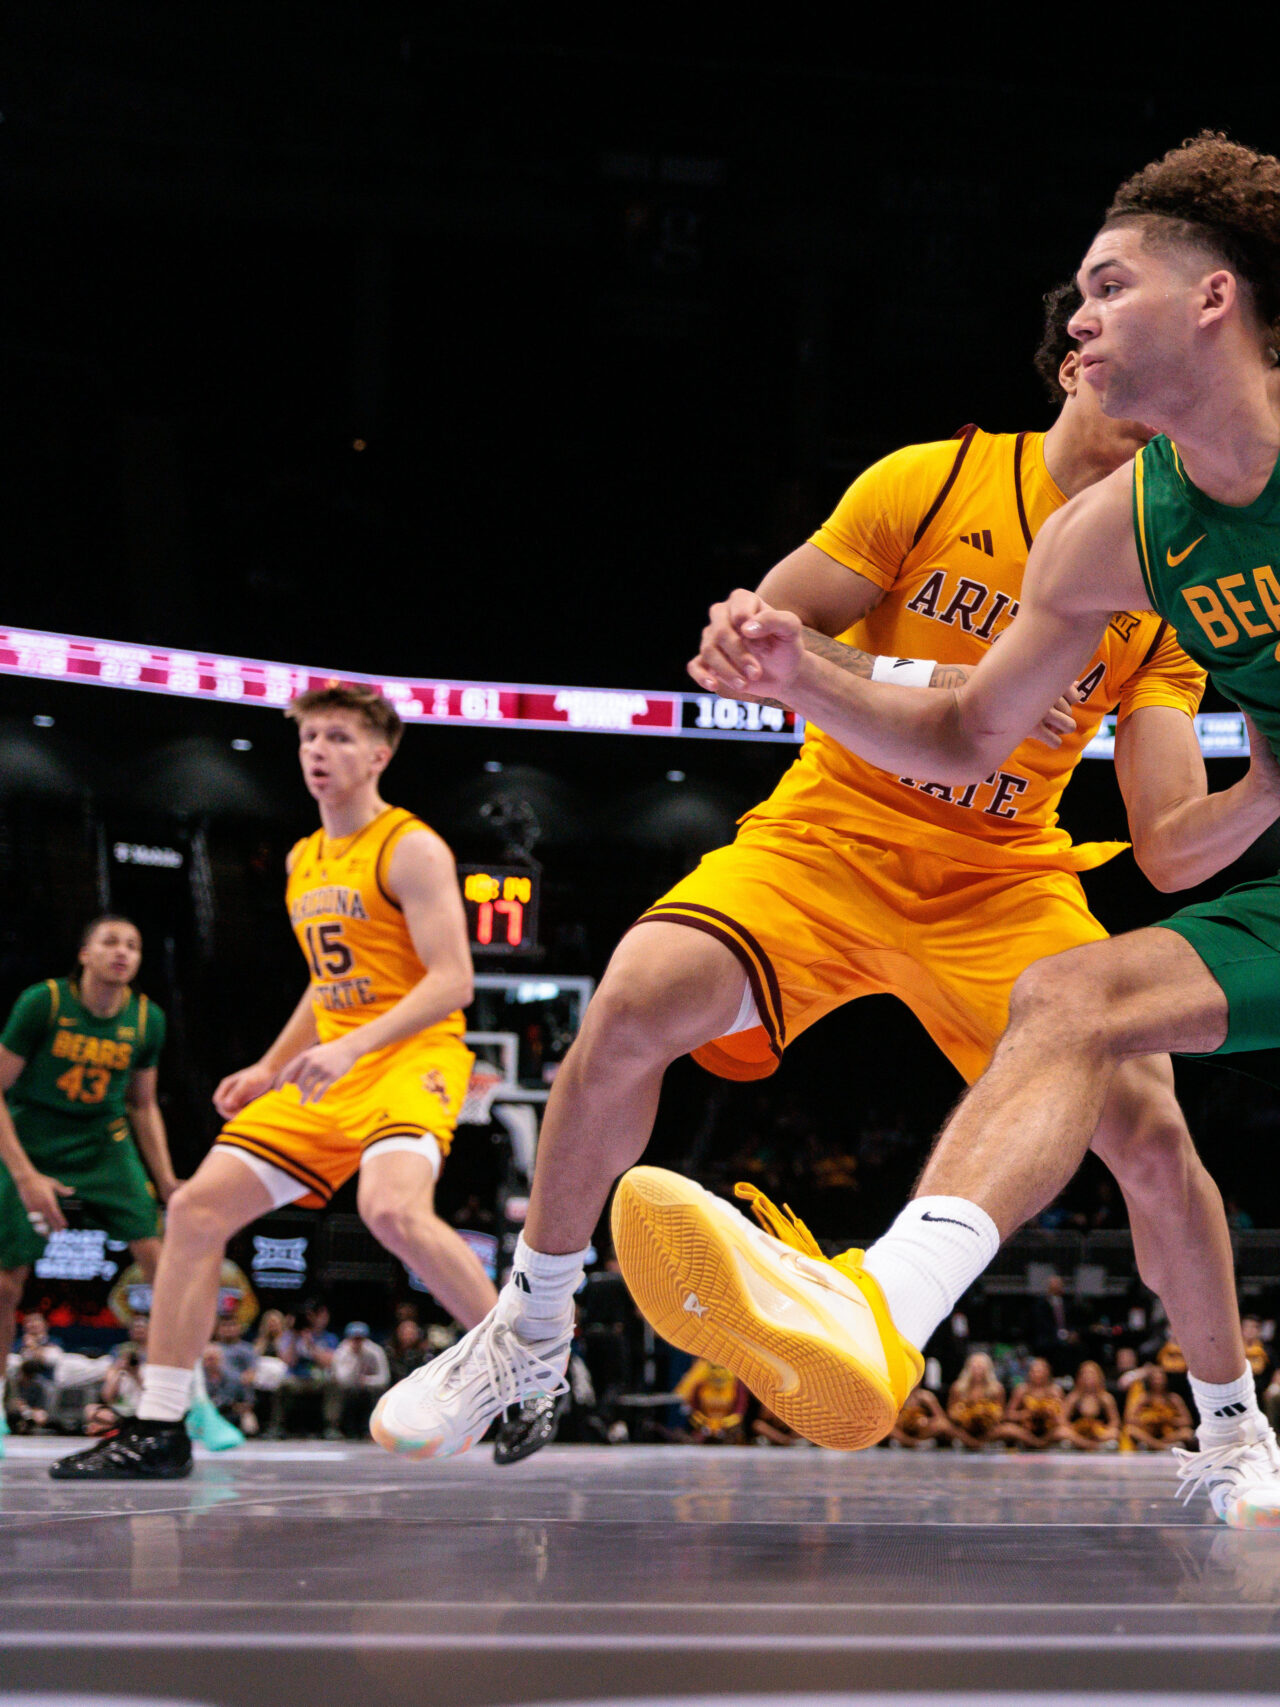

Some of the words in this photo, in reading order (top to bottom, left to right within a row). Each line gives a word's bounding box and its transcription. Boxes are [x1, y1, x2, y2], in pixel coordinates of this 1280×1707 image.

[904, 569, 1107, 705] ARIA
[696, 696, 785, 731] 10:14
[477, 899, 524, 947] 17
[305, 922, 355, 977] 15
[52, 1029, 133, 1071] BEARS
[56, 1063, 112, 1104] 43
